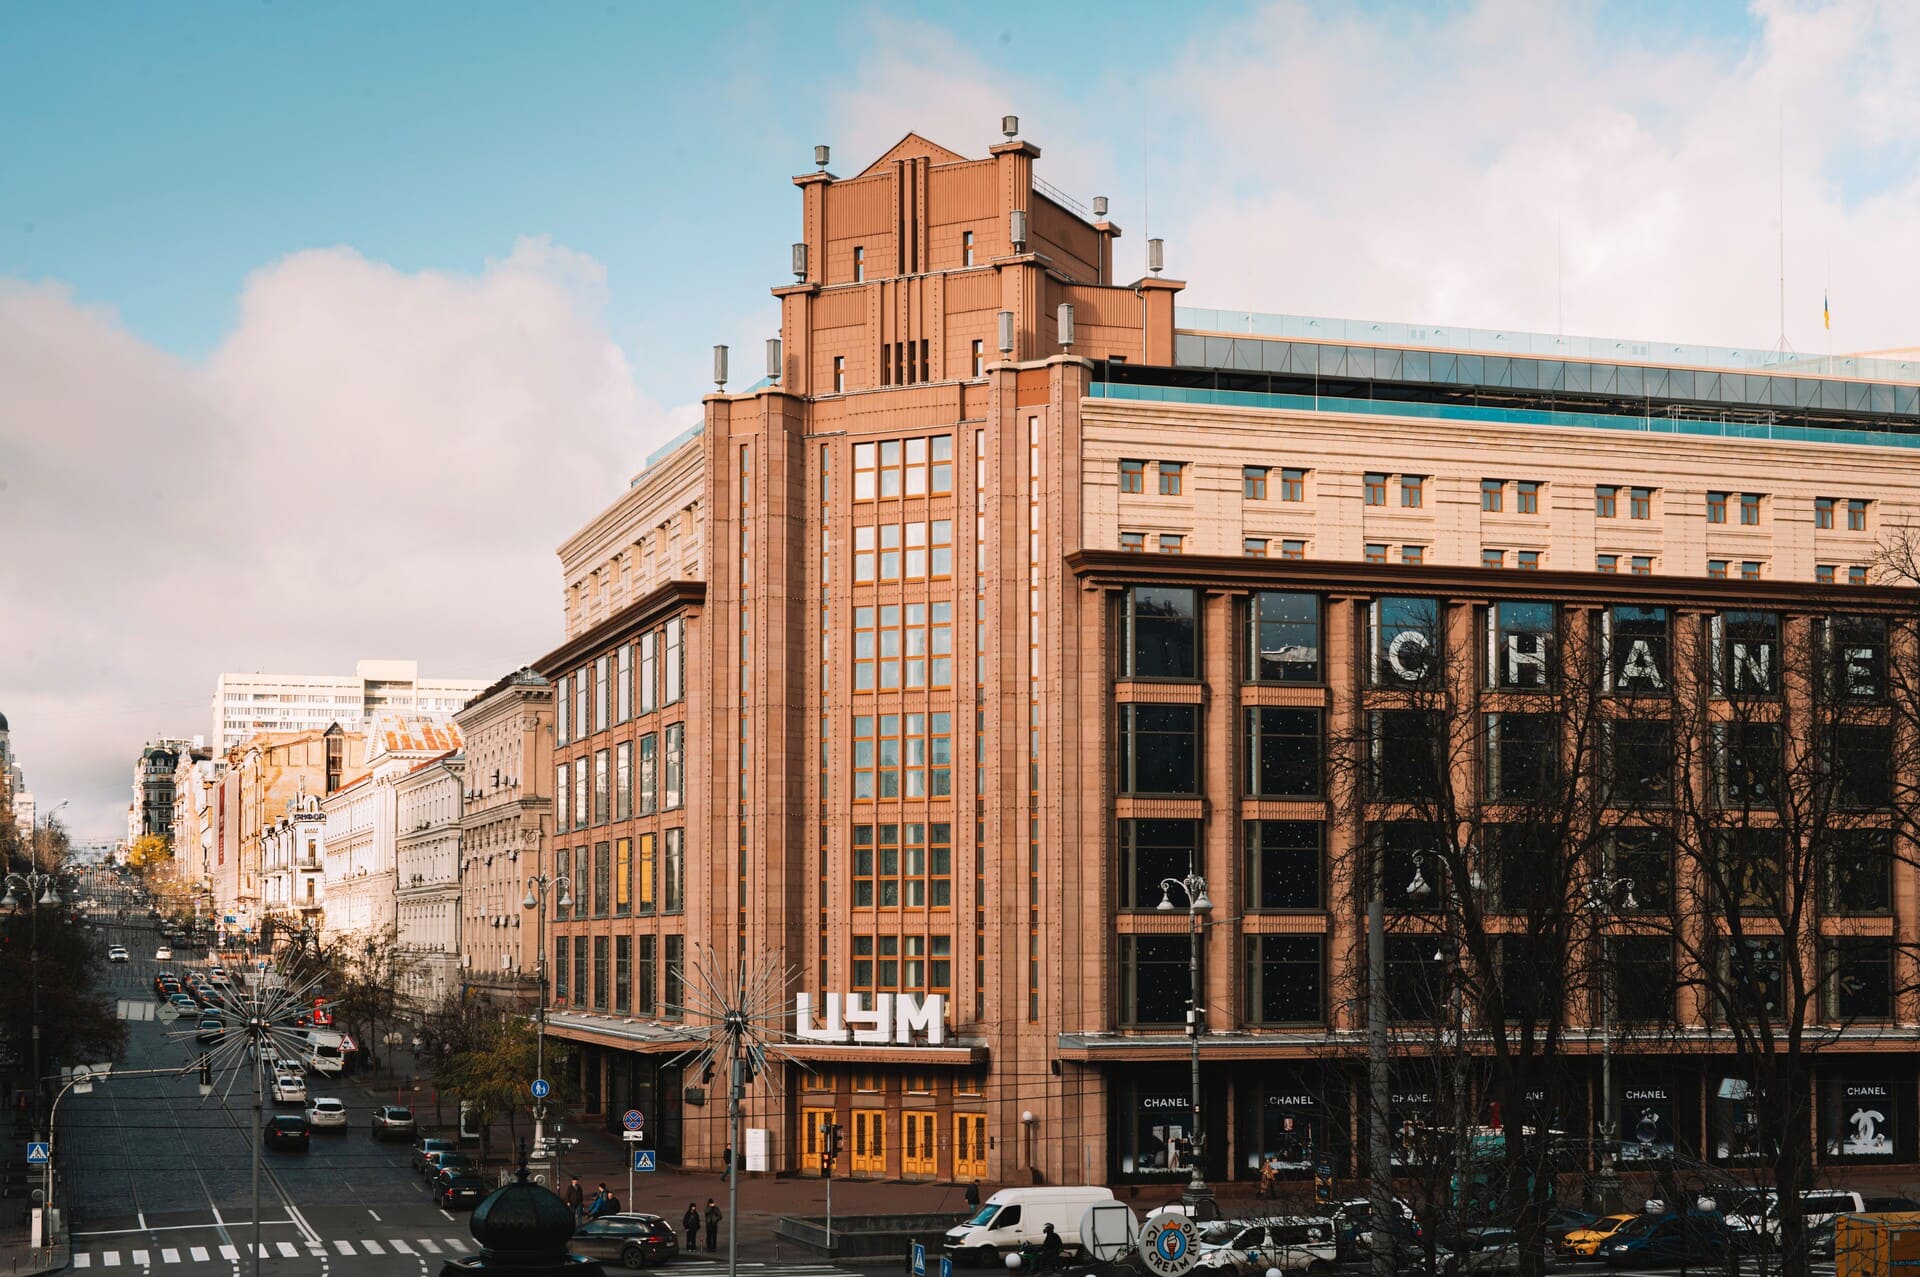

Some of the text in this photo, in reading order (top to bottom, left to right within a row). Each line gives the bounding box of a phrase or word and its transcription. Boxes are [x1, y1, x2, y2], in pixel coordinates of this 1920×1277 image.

[796, 992, 944, 1044] ЦУМ
[1625, 1090, 1667, 1099] CHANEL
[1847, 1087, 1887, 1096] CHANEL
[1144, 1098, 1190, 1108] CHANEL
[1269, 1095, 1314, 1105] CHANEL
[1146, 1223, 1198, 1273] ICE CREAM KING
